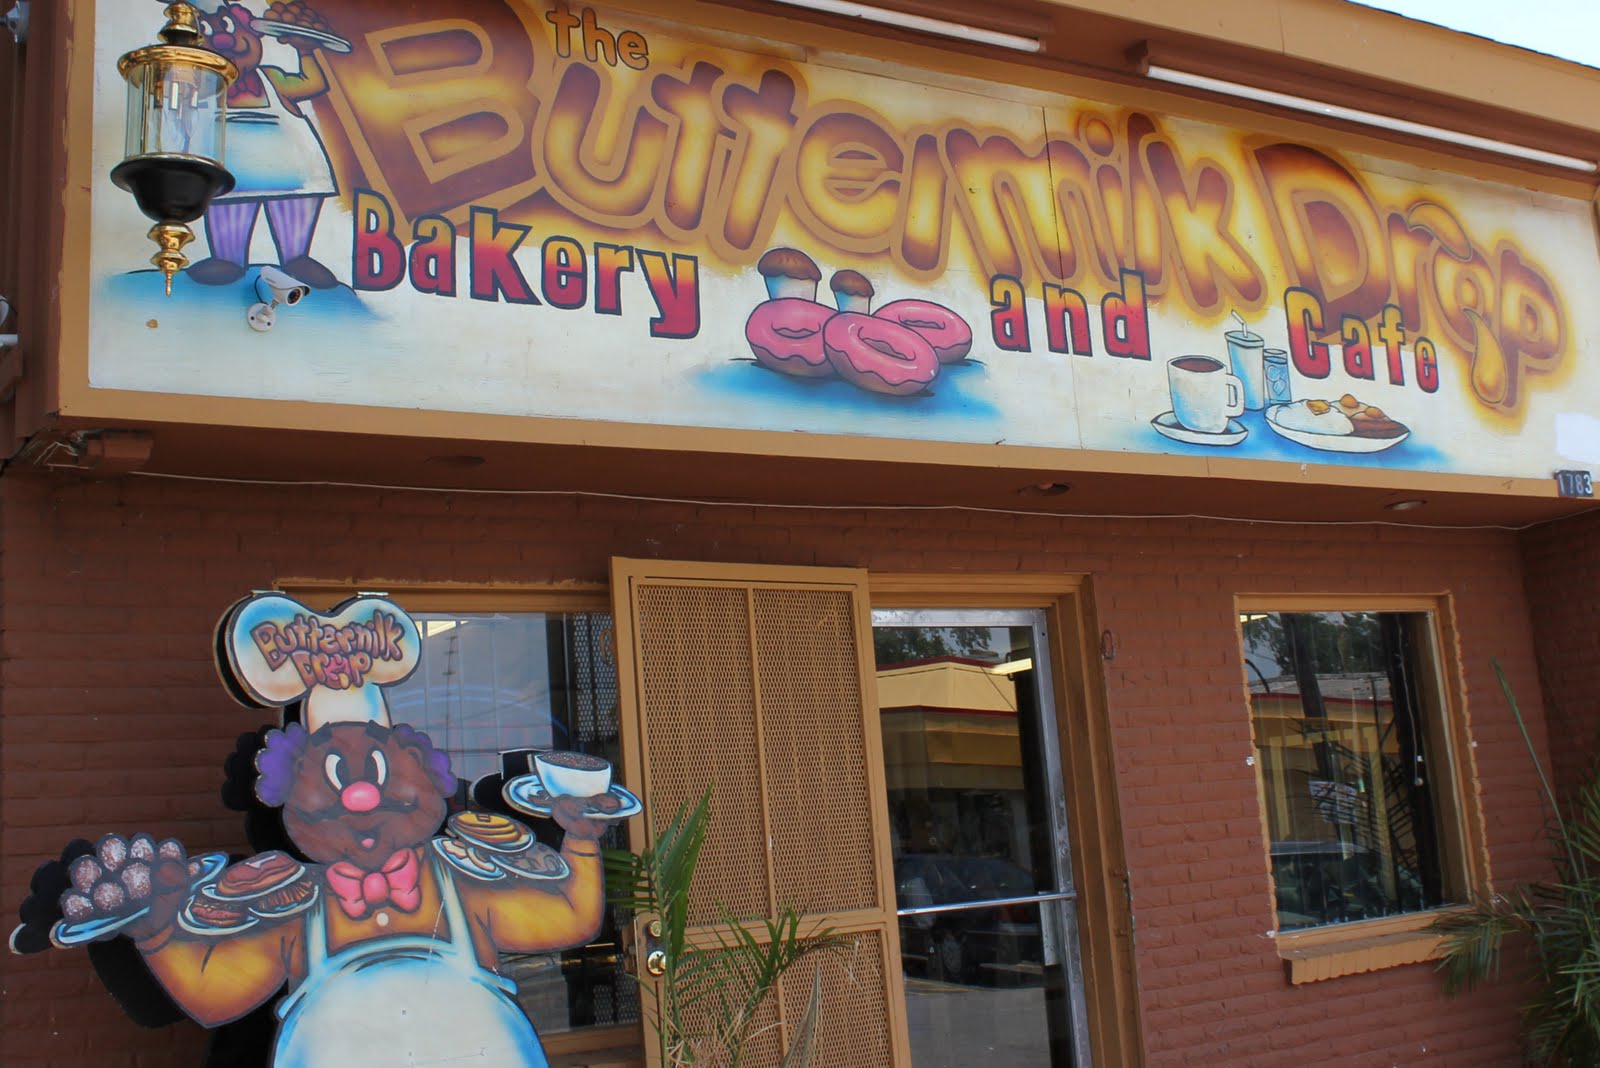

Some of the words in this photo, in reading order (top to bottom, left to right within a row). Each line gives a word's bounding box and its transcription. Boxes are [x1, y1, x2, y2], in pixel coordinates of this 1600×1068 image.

[545, 7, 649, 70] the
[314, 0, 1268, 314] Buttermilk
[1246, 141, 1569, 411] Drop
[352, 187, 701, 340] Bakery
[989, 268, 1152, 361] and
[1284, 286, 1440, 394] Cafe
[1557, 473, 1593, 495] 1783
[250, 608, 406, 672] Buttermilk
